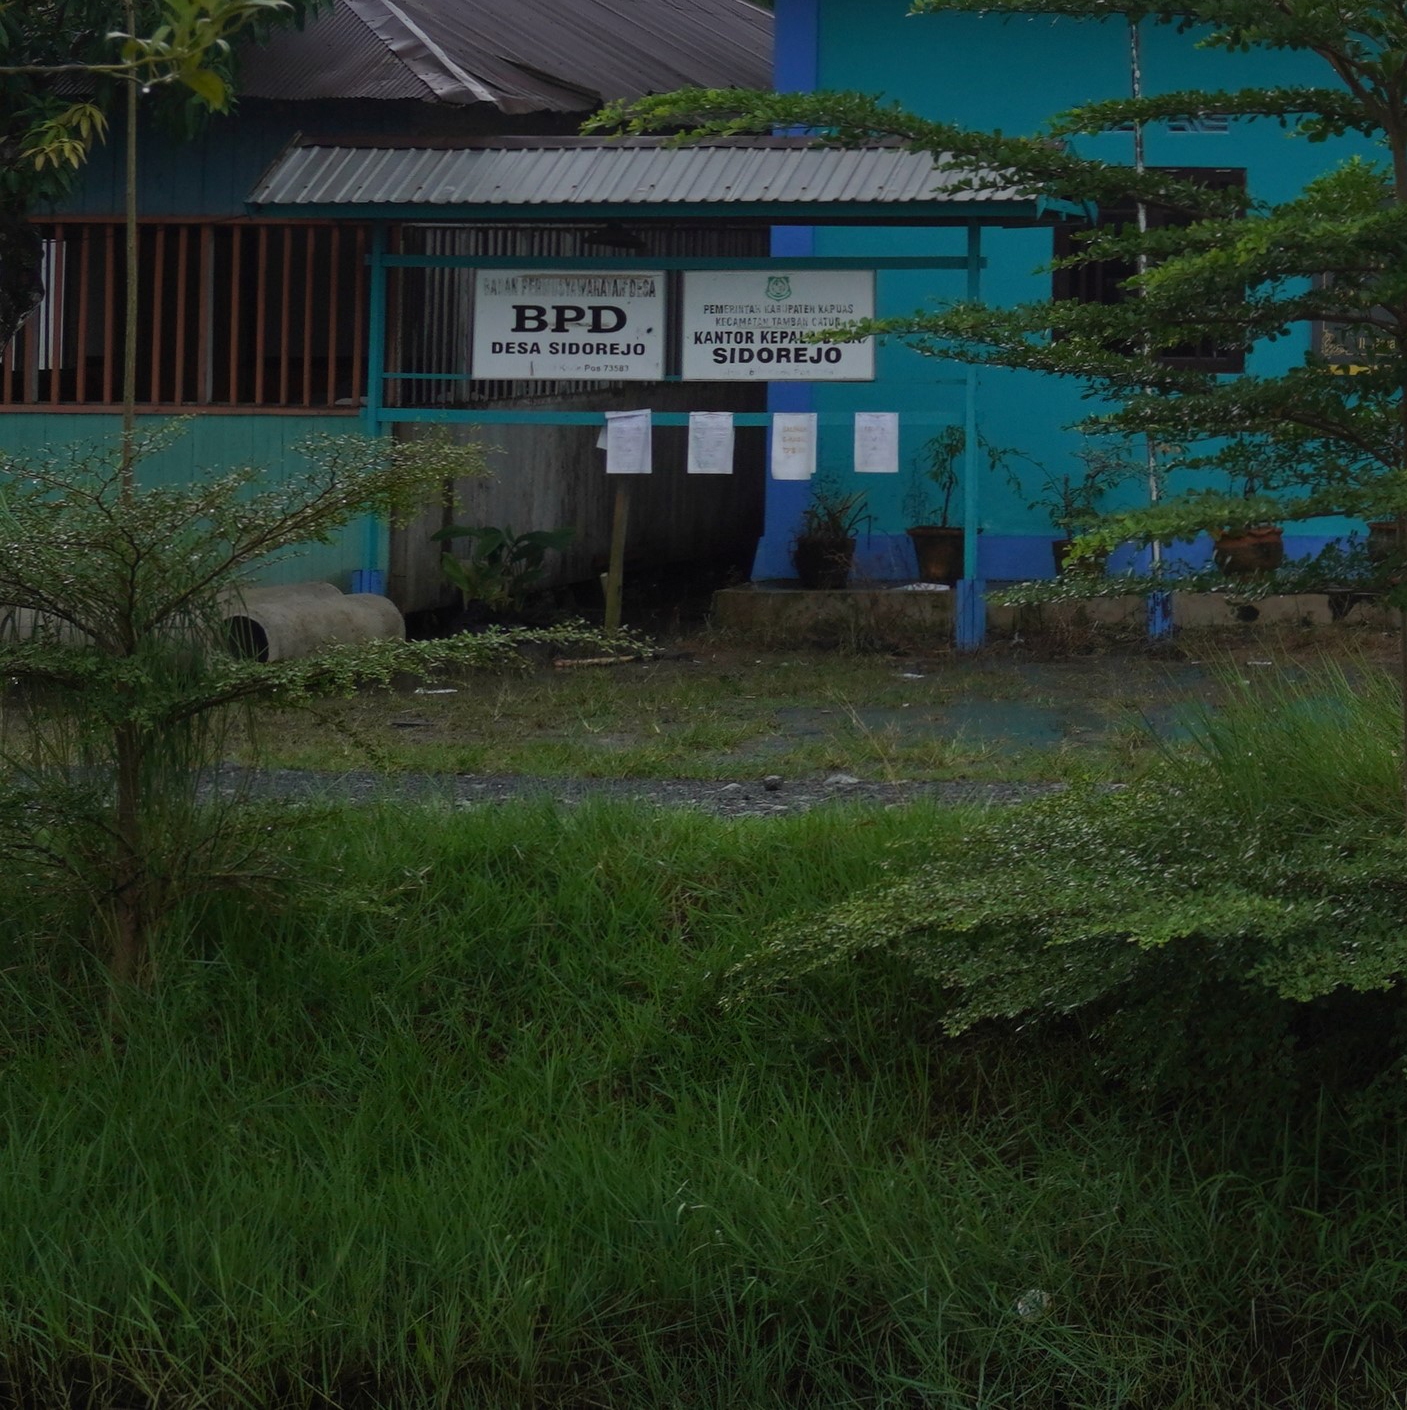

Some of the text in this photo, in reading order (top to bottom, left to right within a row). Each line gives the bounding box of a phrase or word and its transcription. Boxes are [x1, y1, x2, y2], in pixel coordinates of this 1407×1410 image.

[510, 304, 628, 334] BPD
[715, 316, 769, 327] KECAMATAN
[772, 316, 809, 327] TAMBAN
[693, 330, 754, 345] KANTOR
[491, 341, 646, 356] DESA SIDOREJO
[712, 346, 843, 365] SIDOREJO
